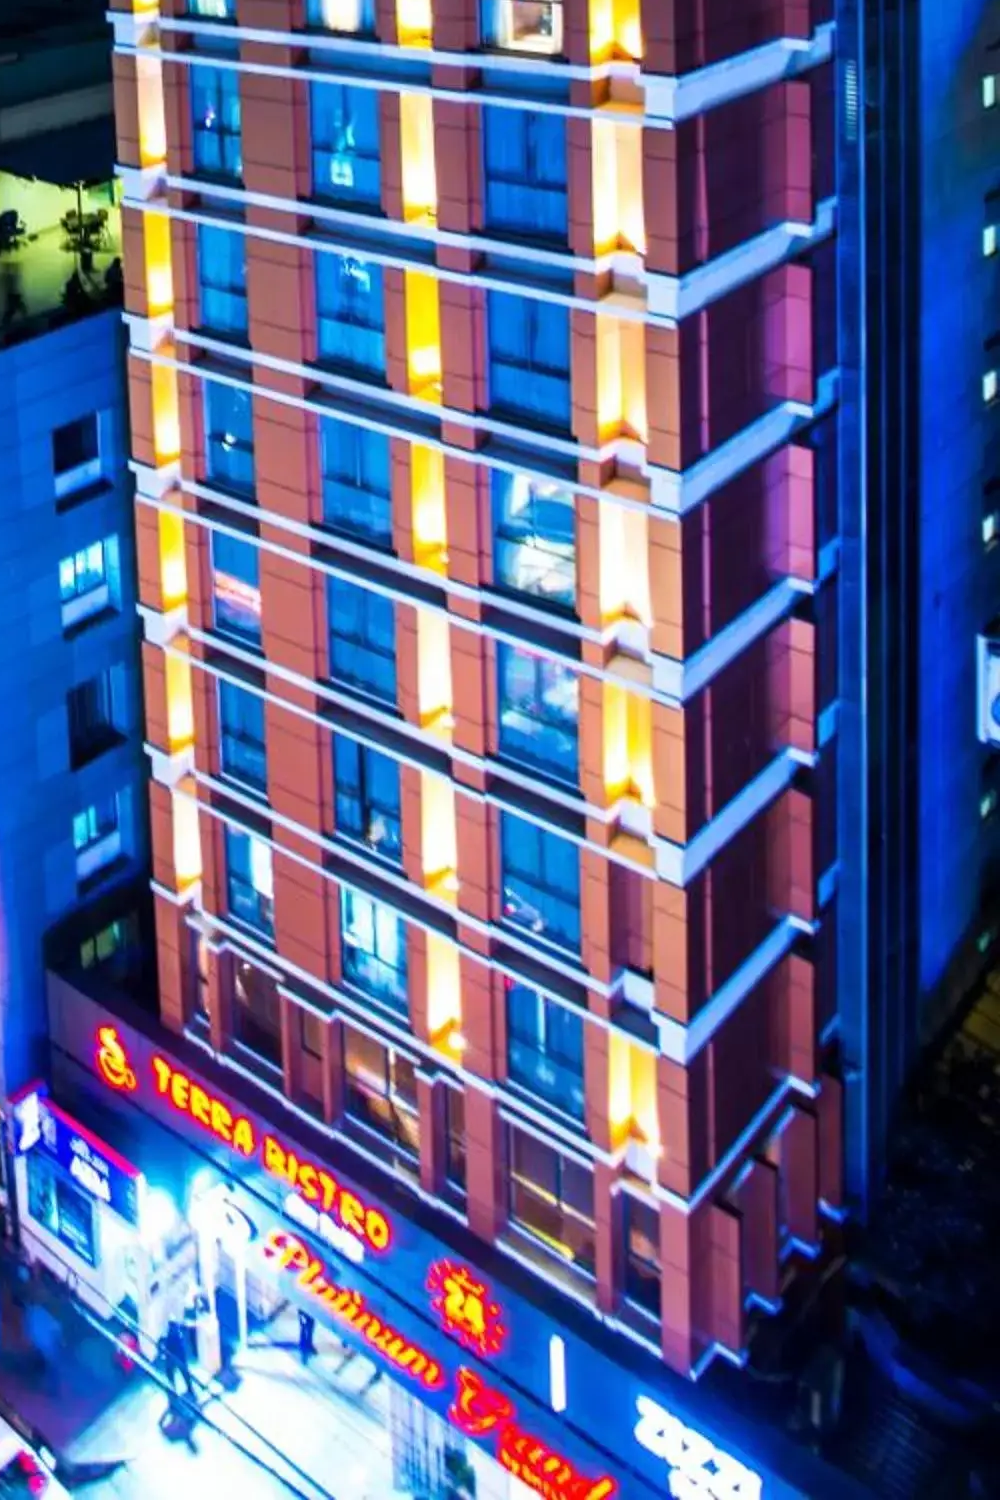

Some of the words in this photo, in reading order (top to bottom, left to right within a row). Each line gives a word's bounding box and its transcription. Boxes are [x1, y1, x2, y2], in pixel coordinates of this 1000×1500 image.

[152, 1056, 255, 1156] TERRA
[263, 1134, 391, 1251] BISTRO
[265, 1231, 443, 1388] Platinum
